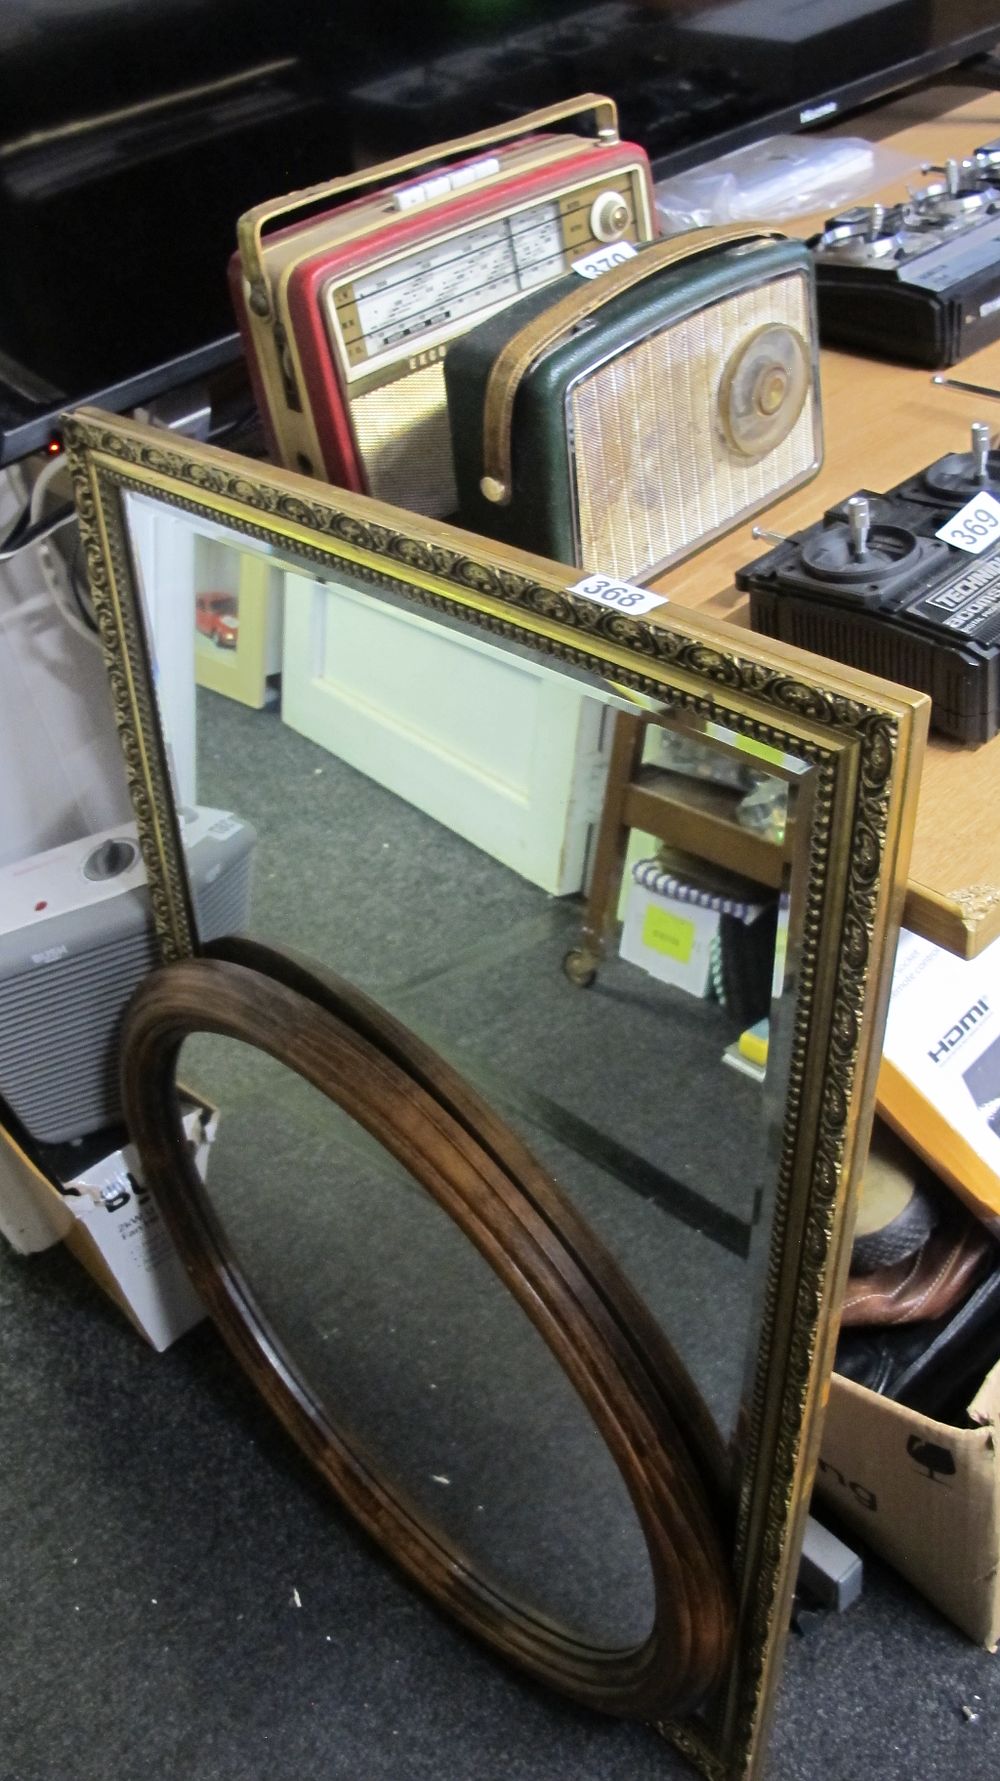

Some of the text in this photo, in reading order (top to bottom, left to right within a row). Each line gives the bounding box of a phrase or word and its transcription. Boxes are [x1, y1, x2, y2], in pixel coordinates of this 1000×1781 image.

[951, 509, 999, 545] 369
[583, 581, 645, 607] 368
[927, 998, 990, 1064] HDMI
